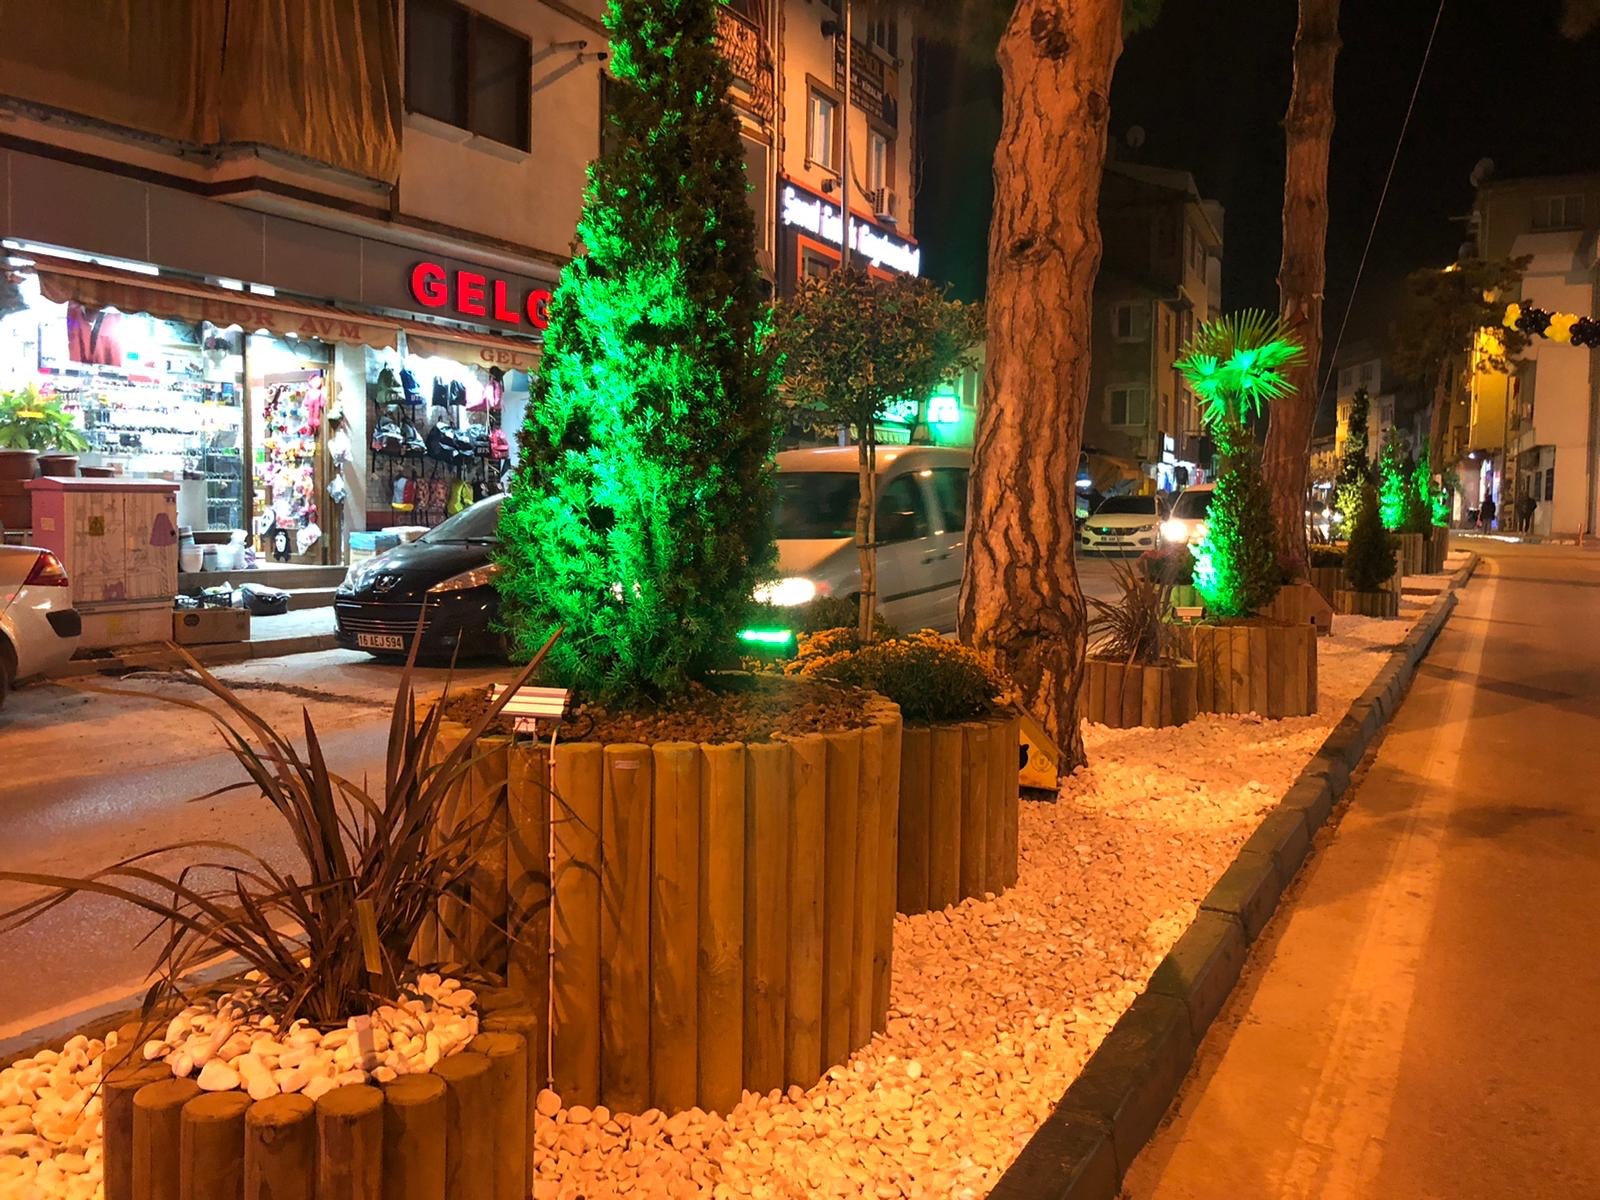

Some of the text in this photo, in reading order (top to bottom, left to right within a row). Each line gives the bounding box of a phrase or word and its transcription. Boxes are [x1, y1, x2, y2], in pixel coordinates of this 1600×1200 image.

[297, 315, 363, 340] AVM
[479, 349, 523, 367] GEL
[385, 636, 402, 649] 594
